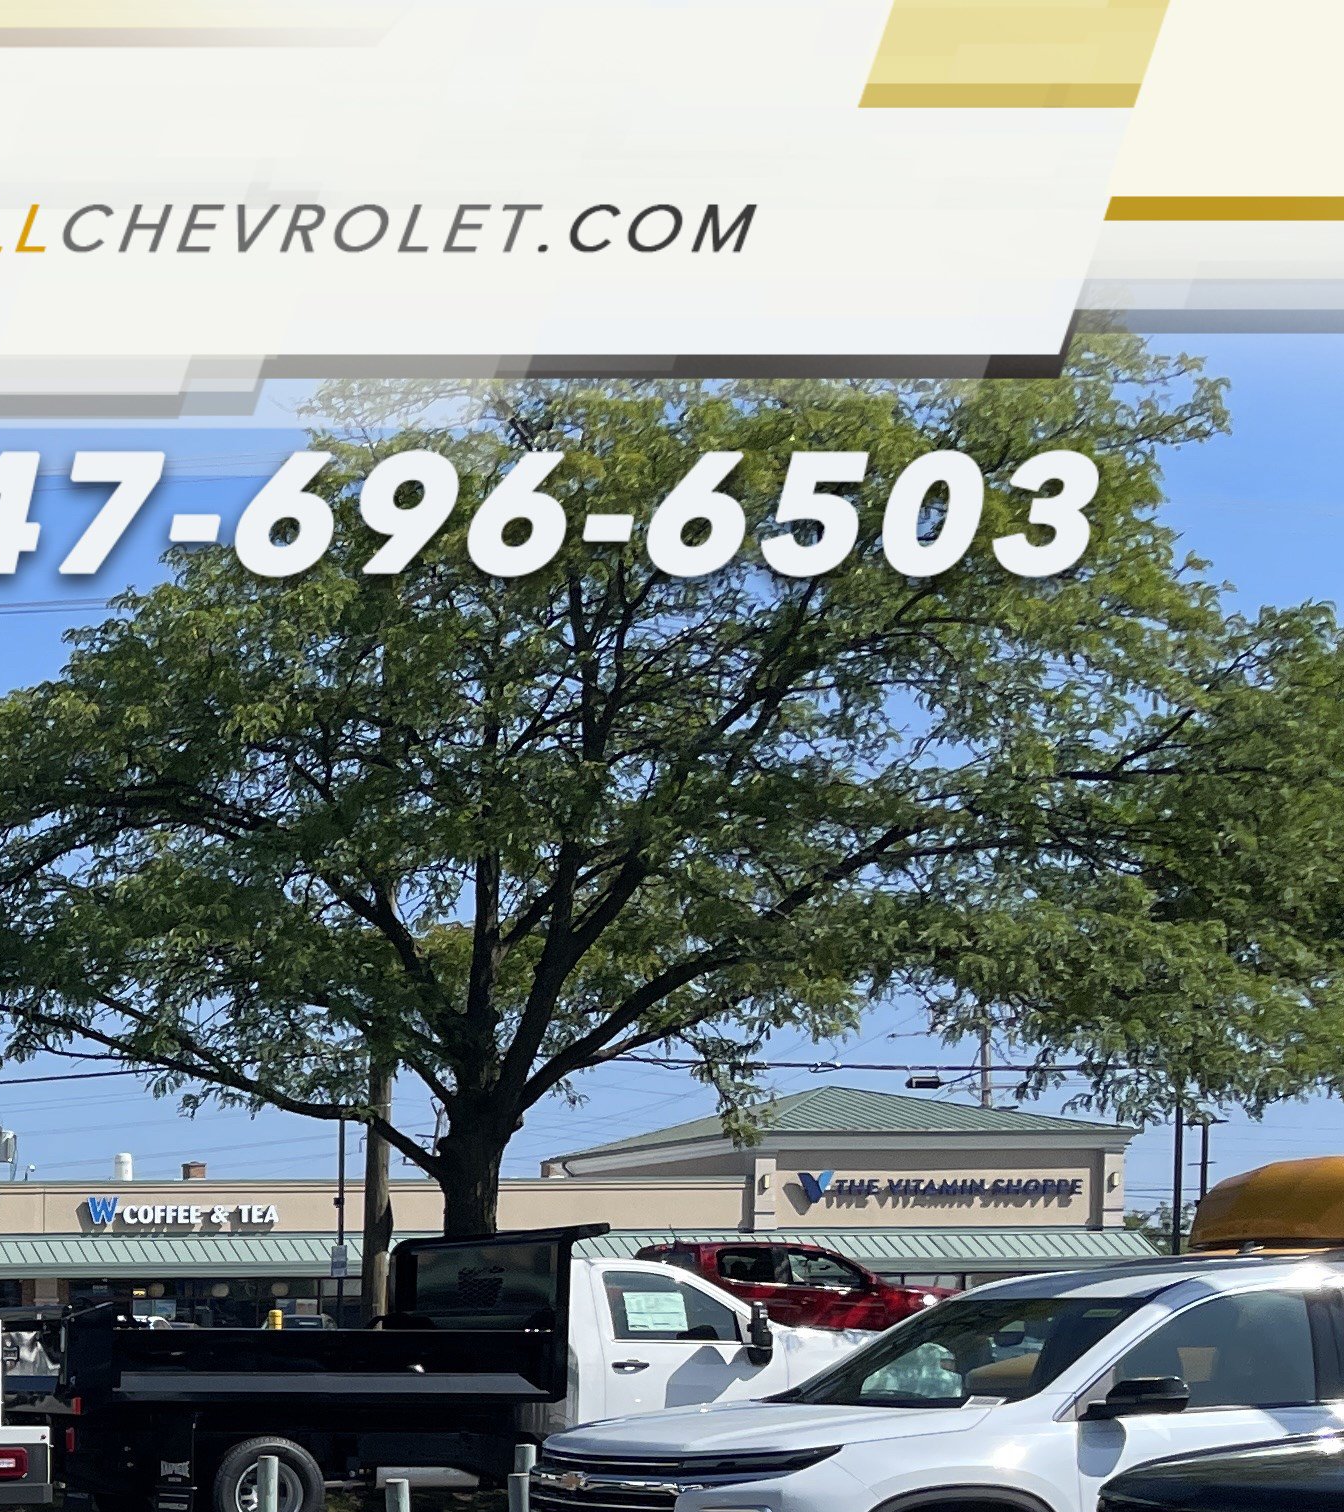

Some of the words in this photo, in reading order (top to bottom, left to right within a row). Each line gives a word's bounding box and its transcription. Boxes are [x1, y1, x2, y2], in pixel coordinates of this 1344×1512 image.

[835, 1178, 880, 1196] THE
[887, 1178, 988, 1196] VITAMIN
[990, 1178, 1083, 1196] SHOPPE
[87, 1196, 120, 1225] W
[122, 1204, 202, 1225] COFFEE
[210, 1204, 230, 1224] &
[238, 1204, 280, 1224] TEA
